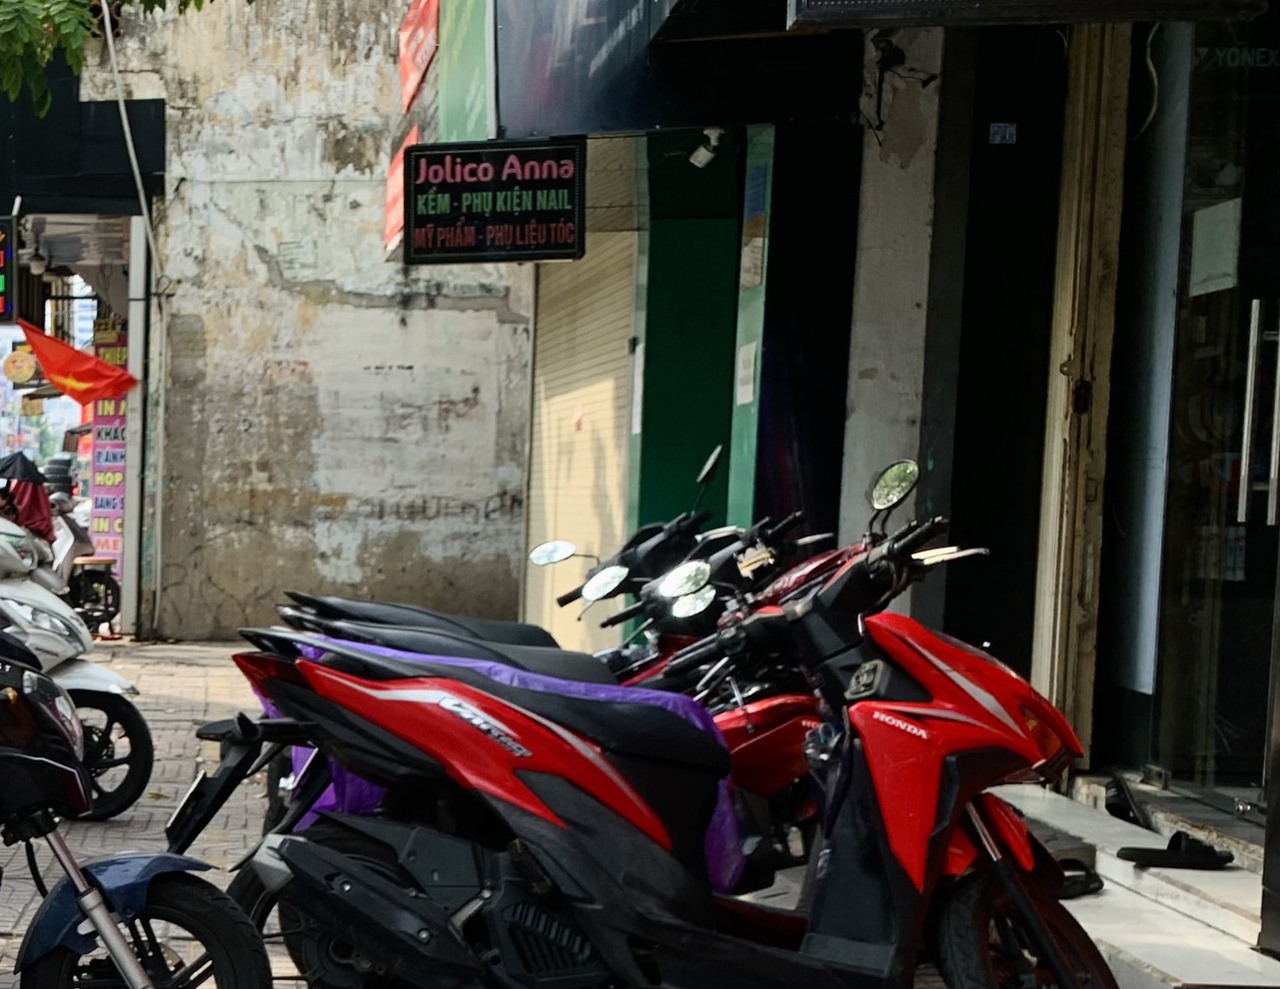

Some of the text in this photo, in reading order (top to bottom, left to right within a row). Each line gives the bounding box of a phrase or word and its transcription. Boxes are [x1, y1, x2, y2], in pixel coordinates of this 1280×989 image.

[415, 154, 574, 184] Jolico Anna
[461, 191, 493, 217] PHỤ
[496, 186, 533, 216] KIỆN
[536, 189, 572, 211] NAIL
[550, 218, 574, 244] TÓC
[872, 711, 928, 740] HONDA
